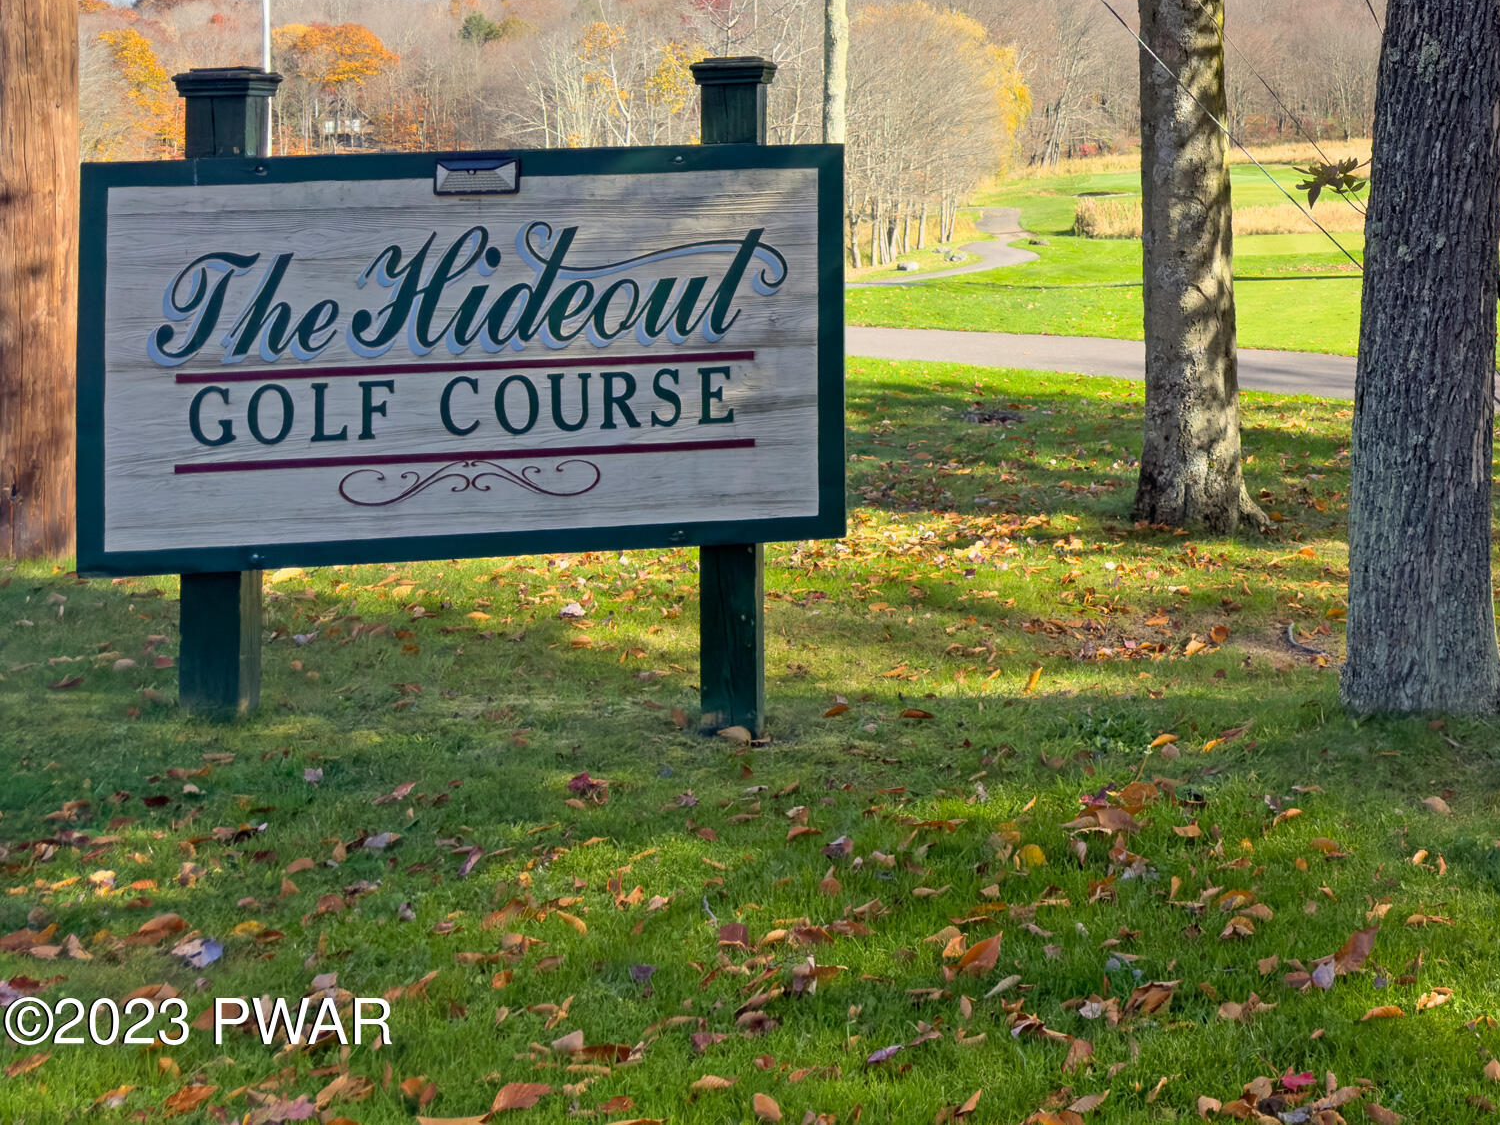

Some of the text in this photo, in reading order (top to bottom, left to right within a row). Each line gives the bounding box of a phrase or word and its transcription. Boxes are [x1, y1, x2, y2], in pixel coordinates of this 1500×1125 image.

[149, 220, 788, 365] The Hideout
[188, 365, 736, 447] GOLF COURSE
